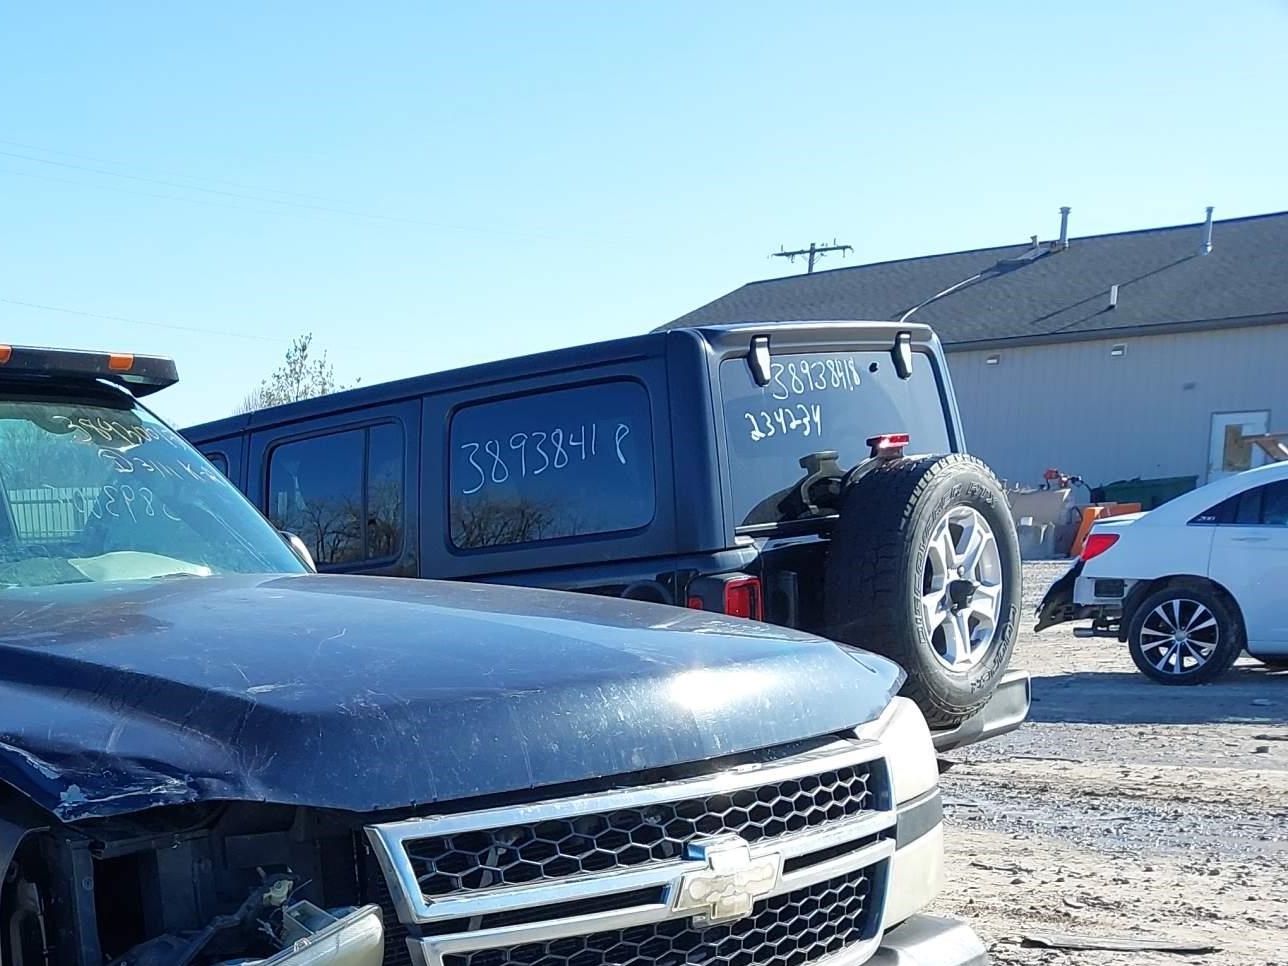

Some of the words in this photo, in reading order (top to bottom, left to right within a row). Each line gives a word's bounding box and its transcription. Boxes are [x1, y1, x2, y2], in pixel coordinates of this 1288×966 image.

[743, 403, 823, 442] 234234
[461, 424, 596, 494] 3893841
[970, 603, 1017, 695] COOPER
